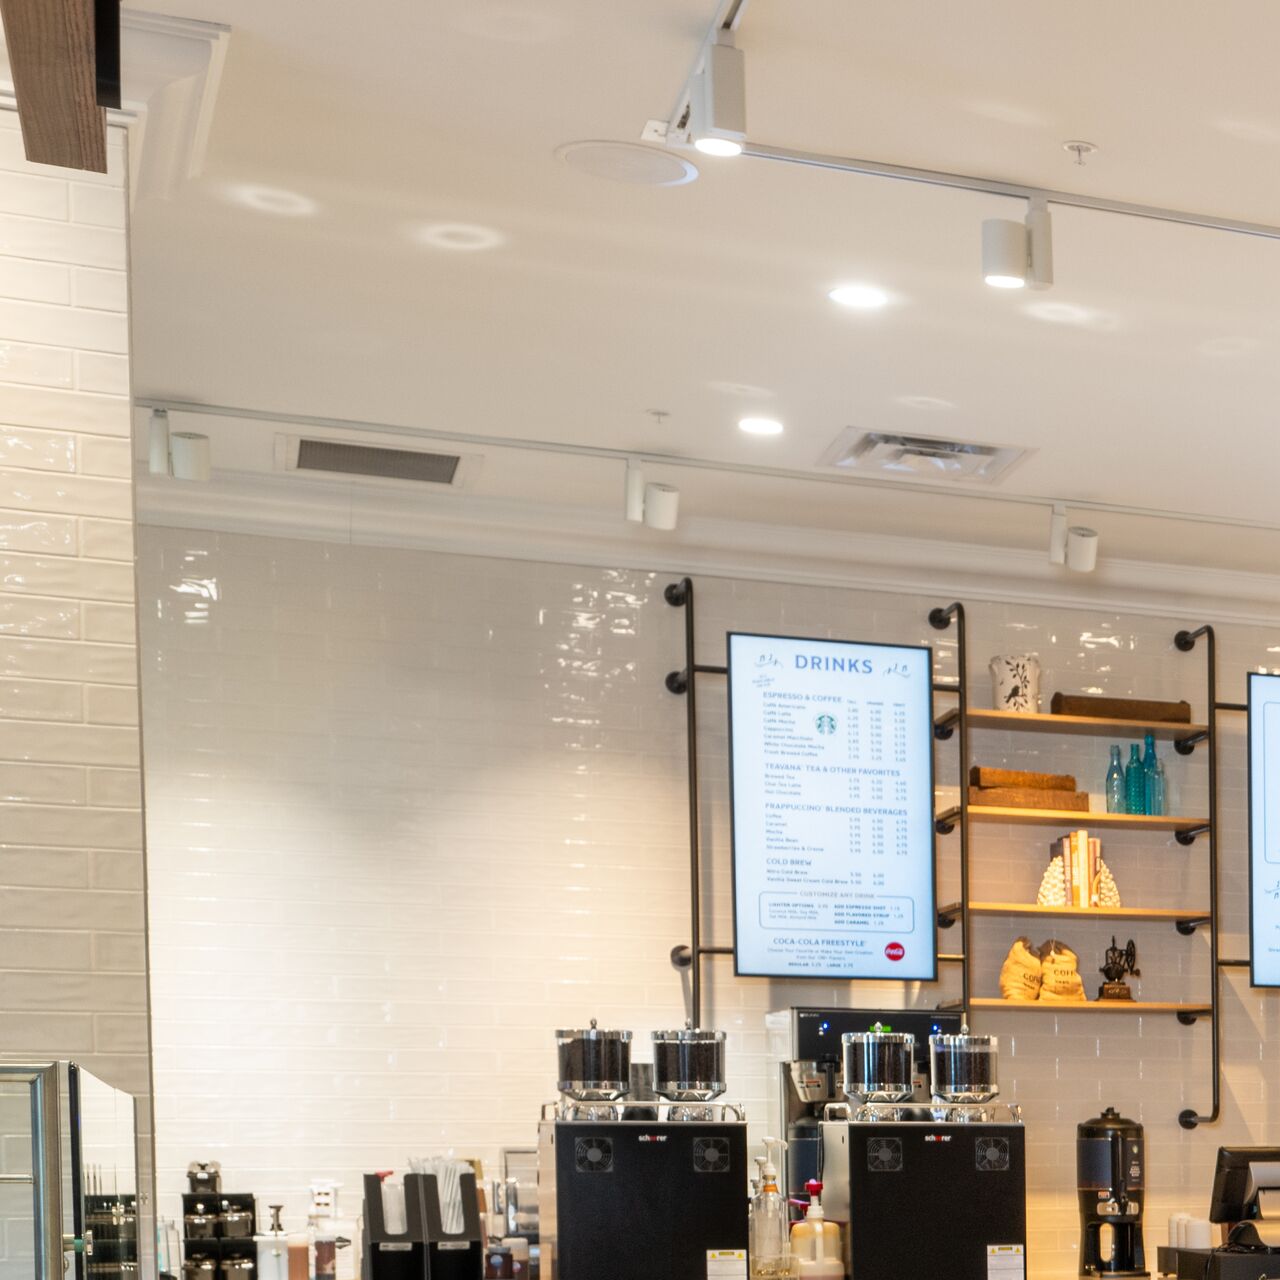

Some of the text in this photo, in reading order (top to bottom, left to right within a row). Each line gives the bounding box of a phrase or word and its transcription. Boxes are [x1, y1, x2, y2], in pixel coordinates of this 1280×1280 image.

[795, 654, 873, 673] DRINKS
[763, 692, 803, 700] ESPRESSO
[830, 766, 857, 774] OTHER
[859, 768, 900, 776] FAVORITES
[826, 806, 861, 814] BLENDED
[863, 808, 907, 816] BEVERAGES
